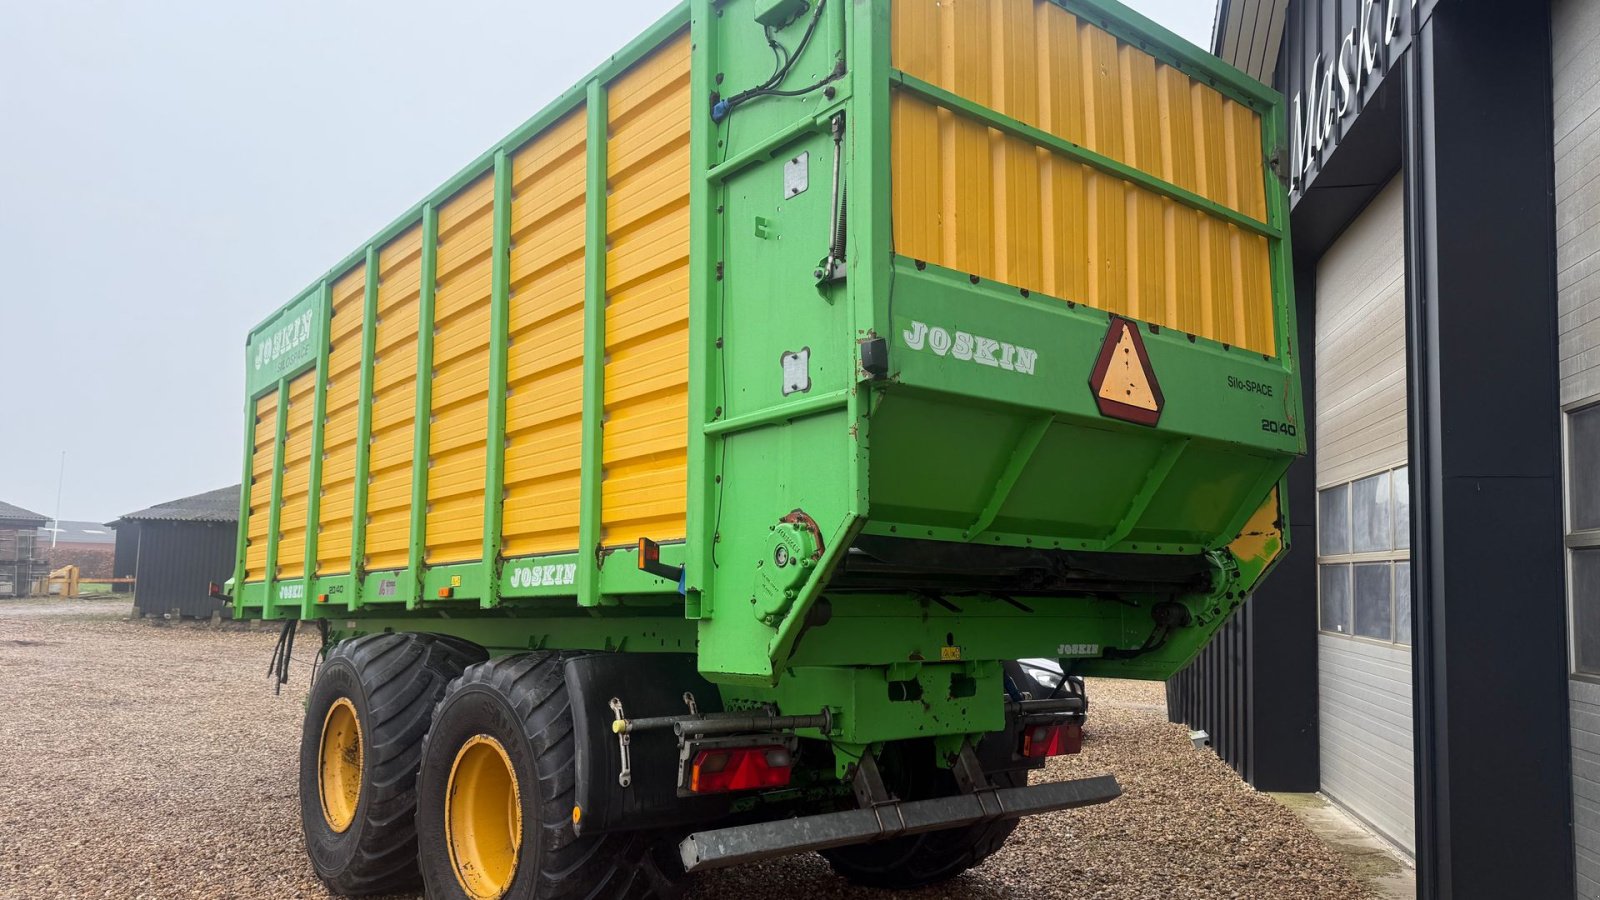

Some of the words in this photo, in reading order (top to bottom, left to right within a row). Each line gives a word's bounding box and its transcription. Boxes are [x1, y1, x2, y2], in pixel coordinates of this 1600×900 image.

[255, 308, 312, 371] JOSKIN
[903, 320, 1038, 375] JOSKIN
[1227, 375, 1273, 397] Silo-SPACE
[510, 563, 576, 588] JOSKIN
[1057, 644, 1099, 655] JOSKIN
